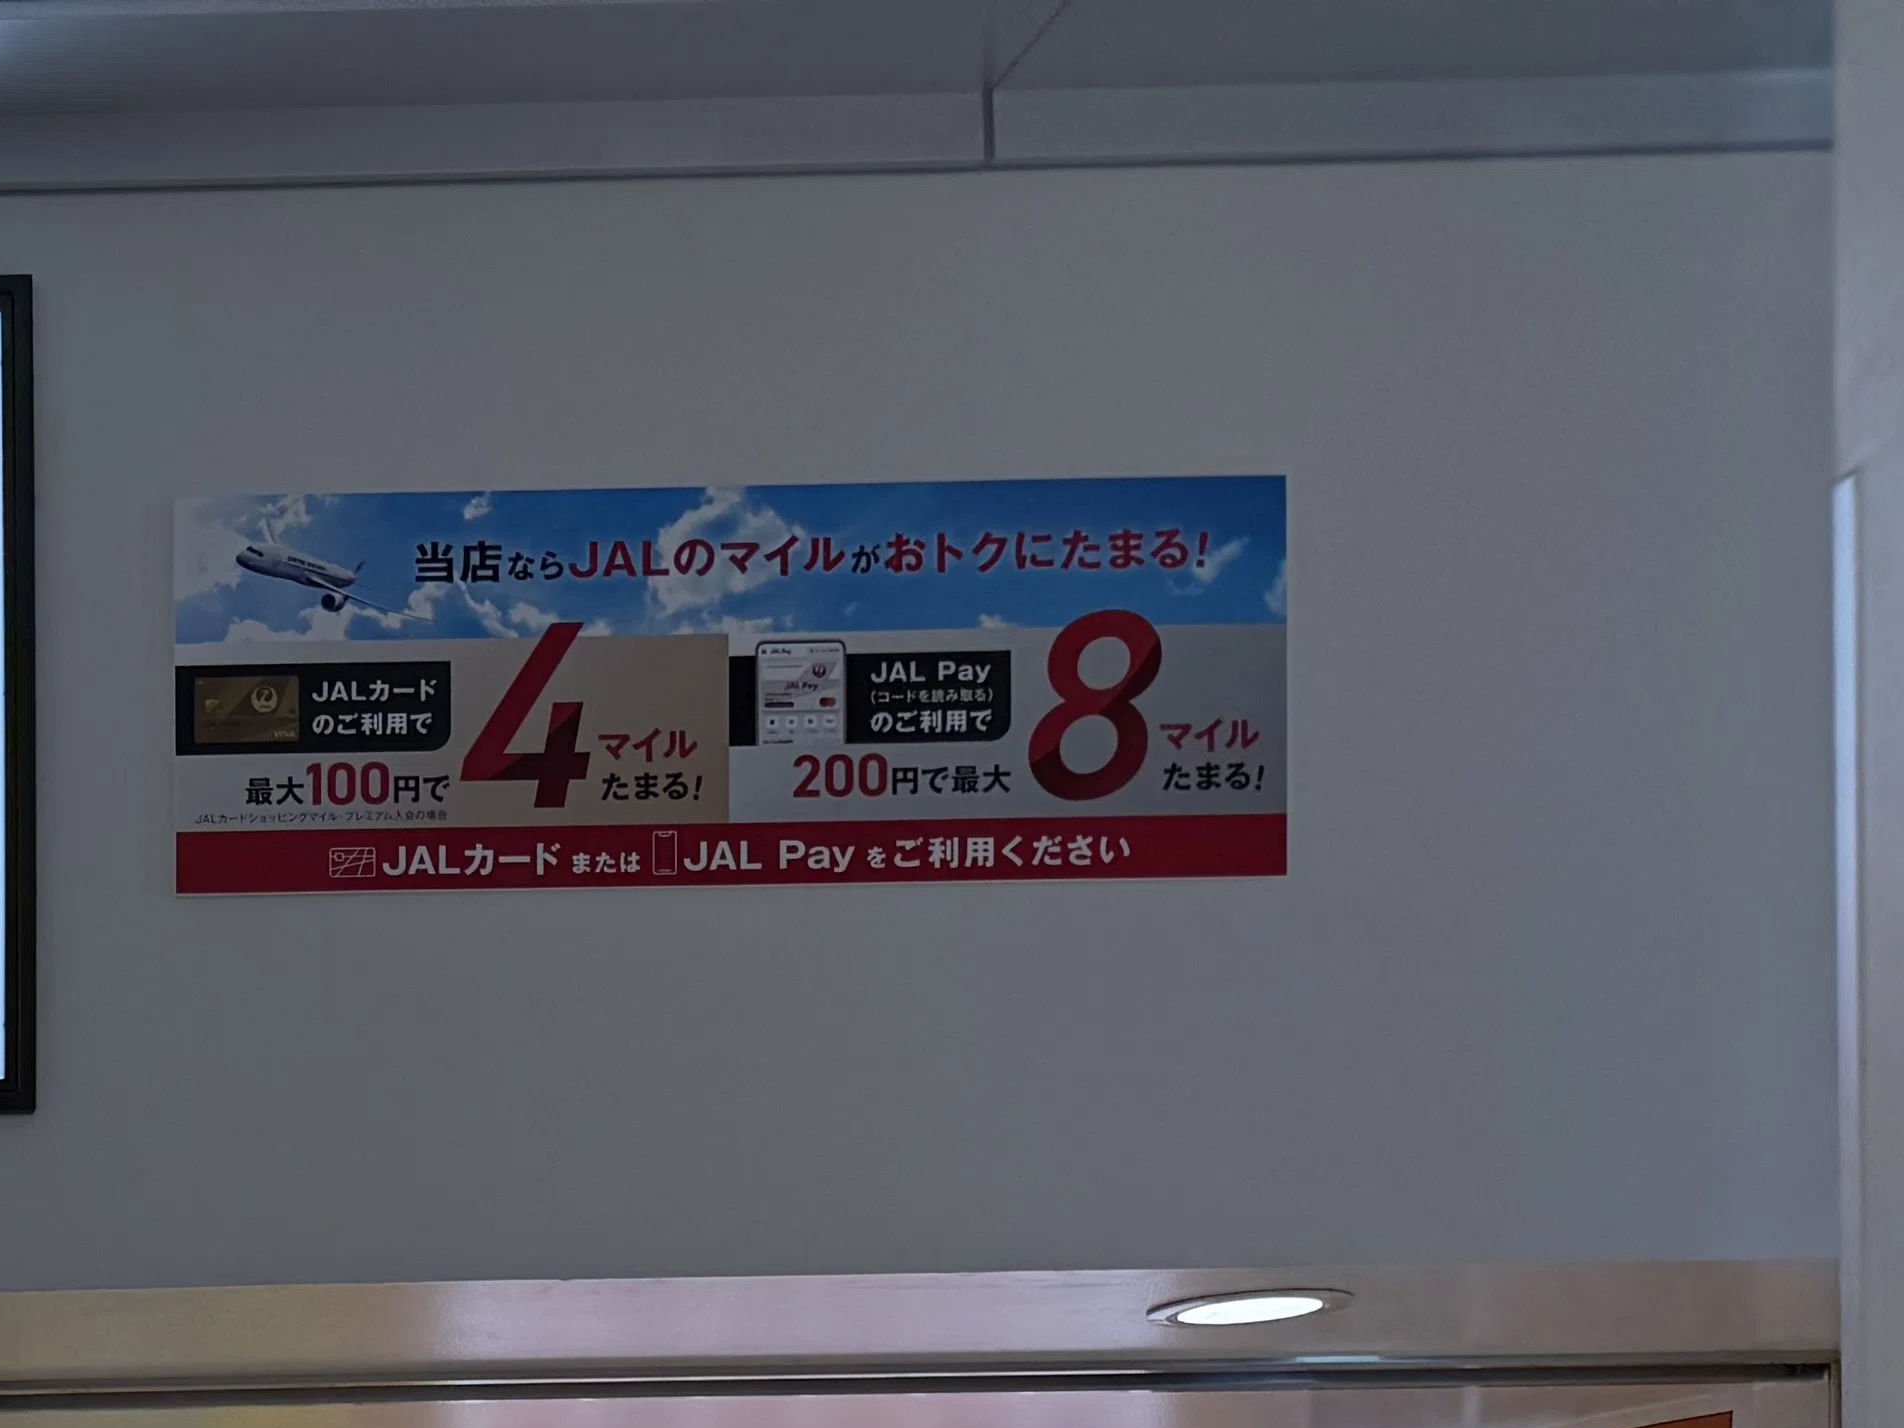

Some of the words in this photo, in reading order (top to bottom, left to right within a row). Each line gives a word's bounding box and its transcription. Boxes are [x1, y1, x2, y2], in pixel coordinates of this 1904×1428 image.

[414, 531, 1210, 584] 当店ならJALのマイルがおトクにたまる!
[870, 660, 932, 684] JAL
[939, 659, 992, 688] Pay
[312, 677, 437, 703] JALカード
[1030, 610, 1163, 801] 8
[313, 710, 433, 736] のご利用で
[460, 623, 590, 808] 4
[870, 709, 992, 733] のご利用で
[599, 727, 697, 760] マイル
[1162, 720, 1259, 752] マイル
[245, 762, 450, 806] 最大100円で
[602, 771, 704, 803] たまる!
[793, 754, 1011, 798] 200円で最大
[1162, 762, 1265, 793] たまる!
[383, 842, 560, 877] JALカード
[572, 851, 641, 875] または
[684, 837, 763, 872] JAL
[779, 837, 855, 878] Pay
